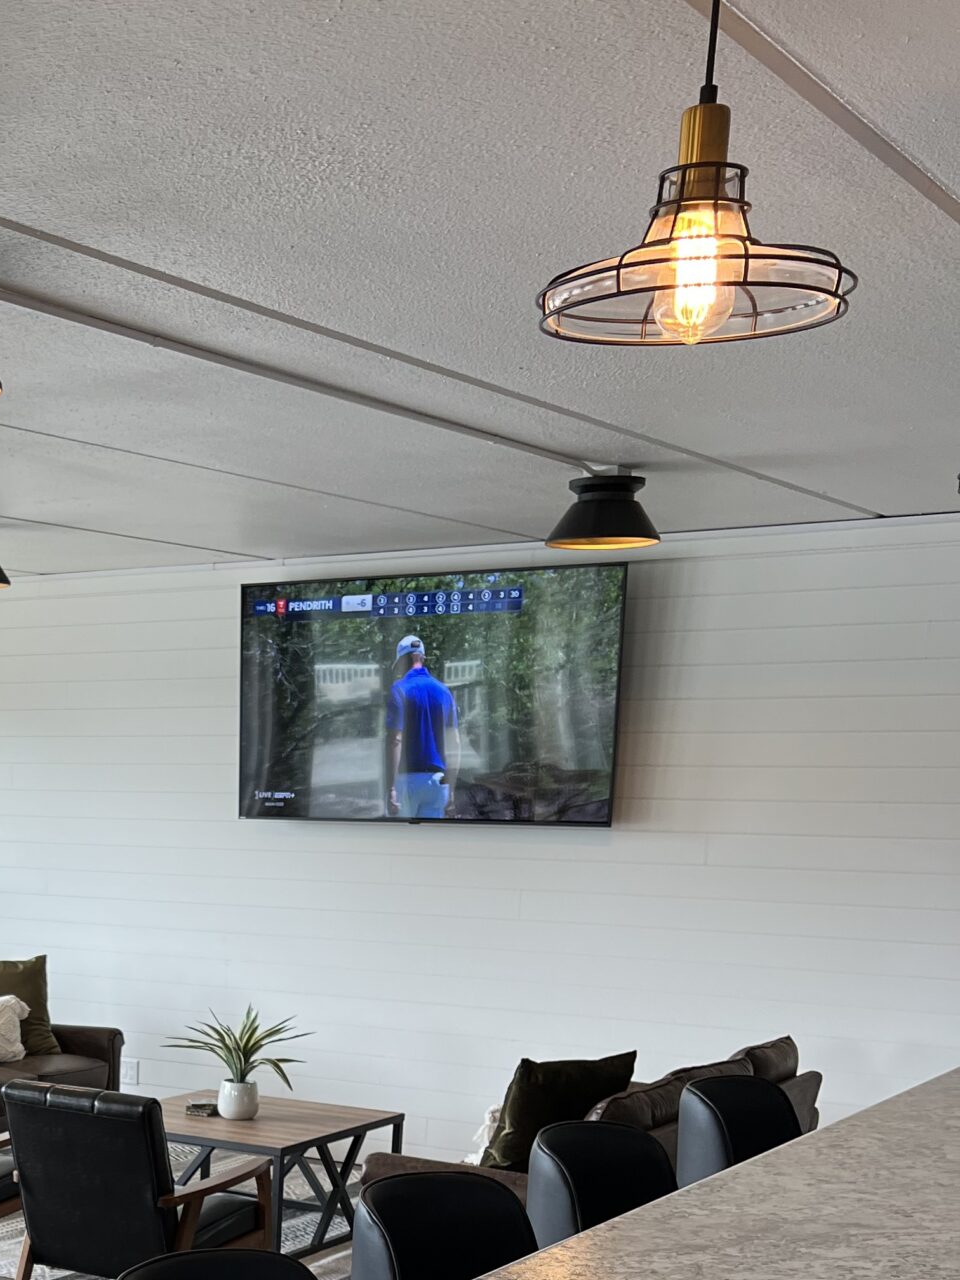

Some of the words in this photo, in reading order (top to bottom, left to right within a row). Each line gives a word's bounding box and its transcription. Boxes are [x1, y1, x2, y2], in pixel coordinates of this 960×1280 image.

[266, 603, 276, 613] 16
[288, 600, 333, 612] PENDRITH
[357, 598, 367, 608] -6
